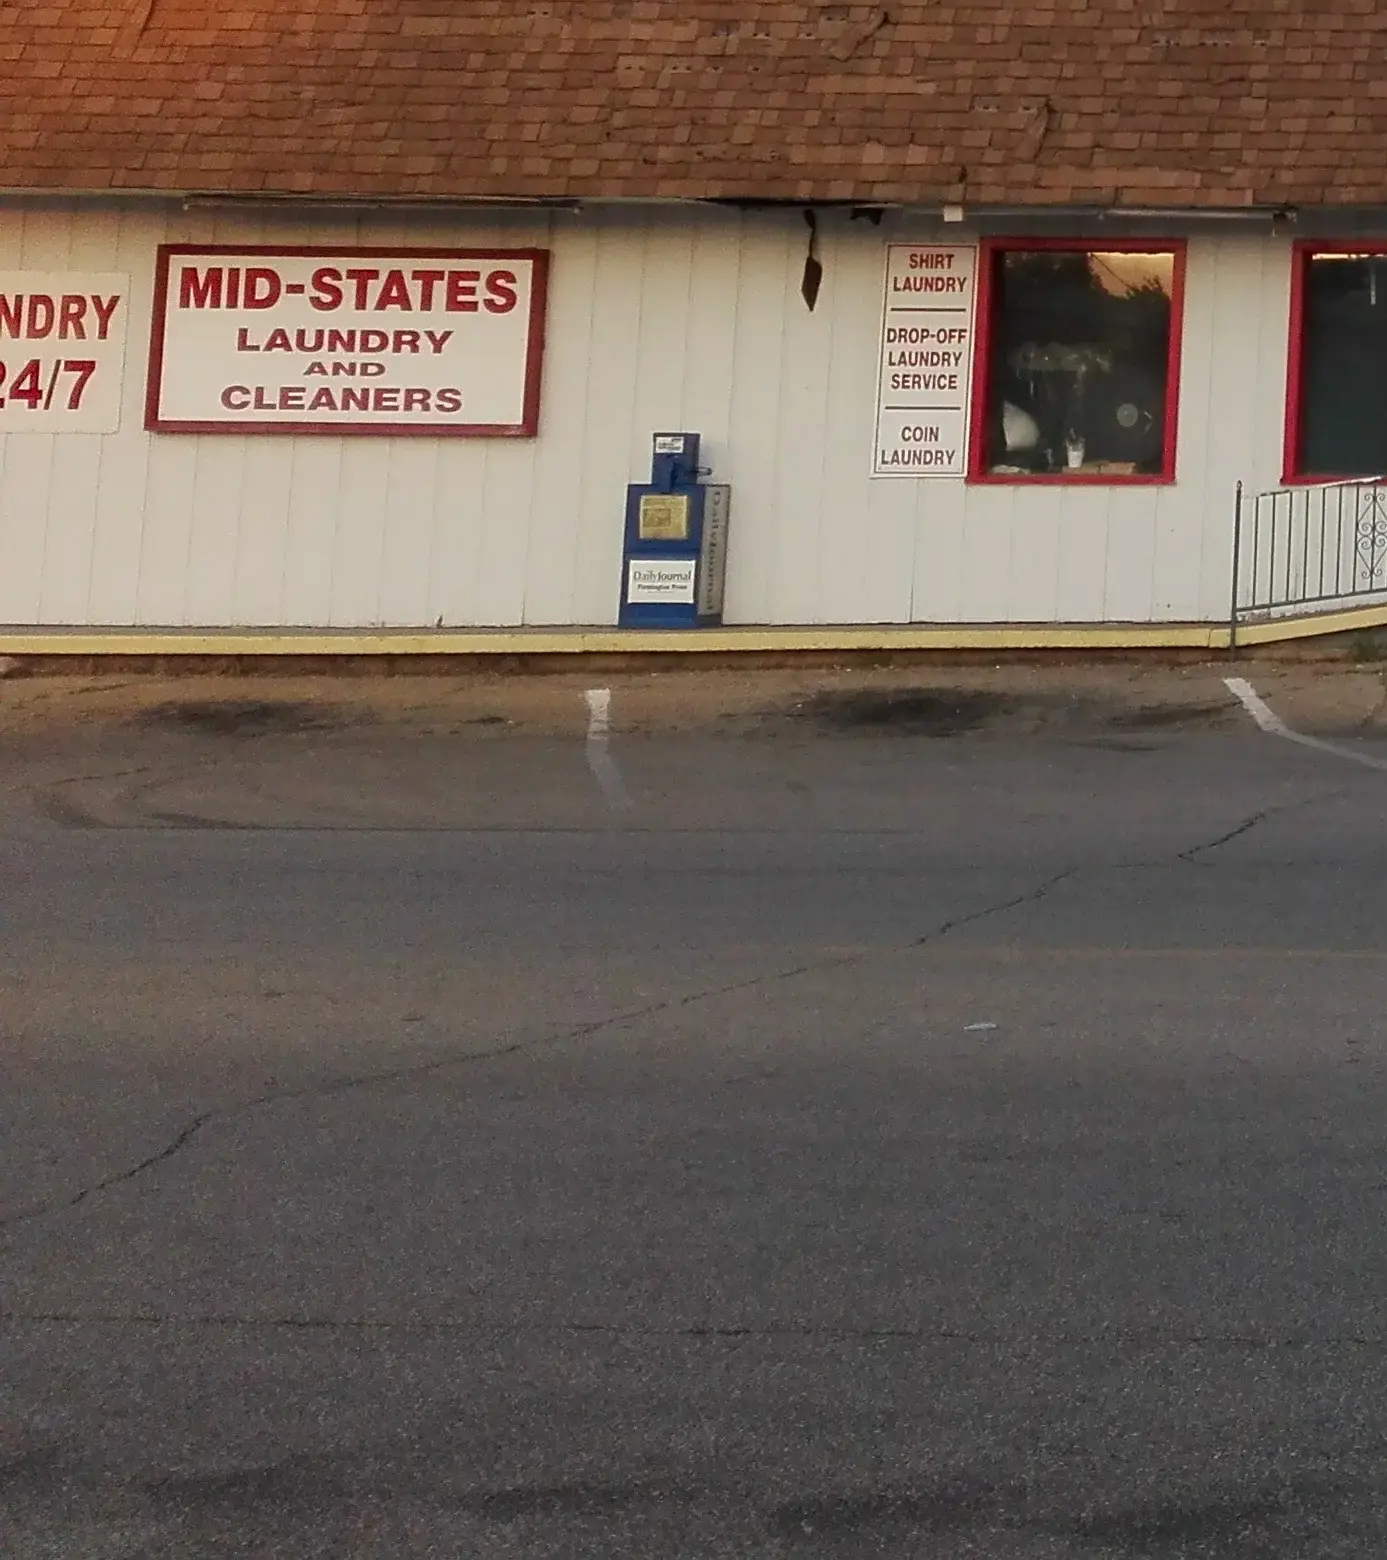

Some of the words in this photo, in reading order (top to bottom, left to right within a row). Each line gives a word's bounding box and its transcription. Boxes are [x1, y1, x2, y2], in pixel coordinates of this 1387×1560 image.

[908, 253, 955, 269] SHIRT
[179, 267, 517, 314] MID-STATES
[893, 277, 967, 293] LAUNDRY
[236, 328, 454, 354] LAUNDRY
[886, 328, 967, 344] DROP-OFF
[888, 351, 963, 367] LAUNDRY
[303, 362, 386, 377] AND
[0, 358, 97, 410] 4/7
[891, 374, 958, 390] SERVICE
[220, 386, 463, 412] CLEANERS
[901, 426, 940, 442] COIN
[881, 449, 956, 466] LAUNDRY
